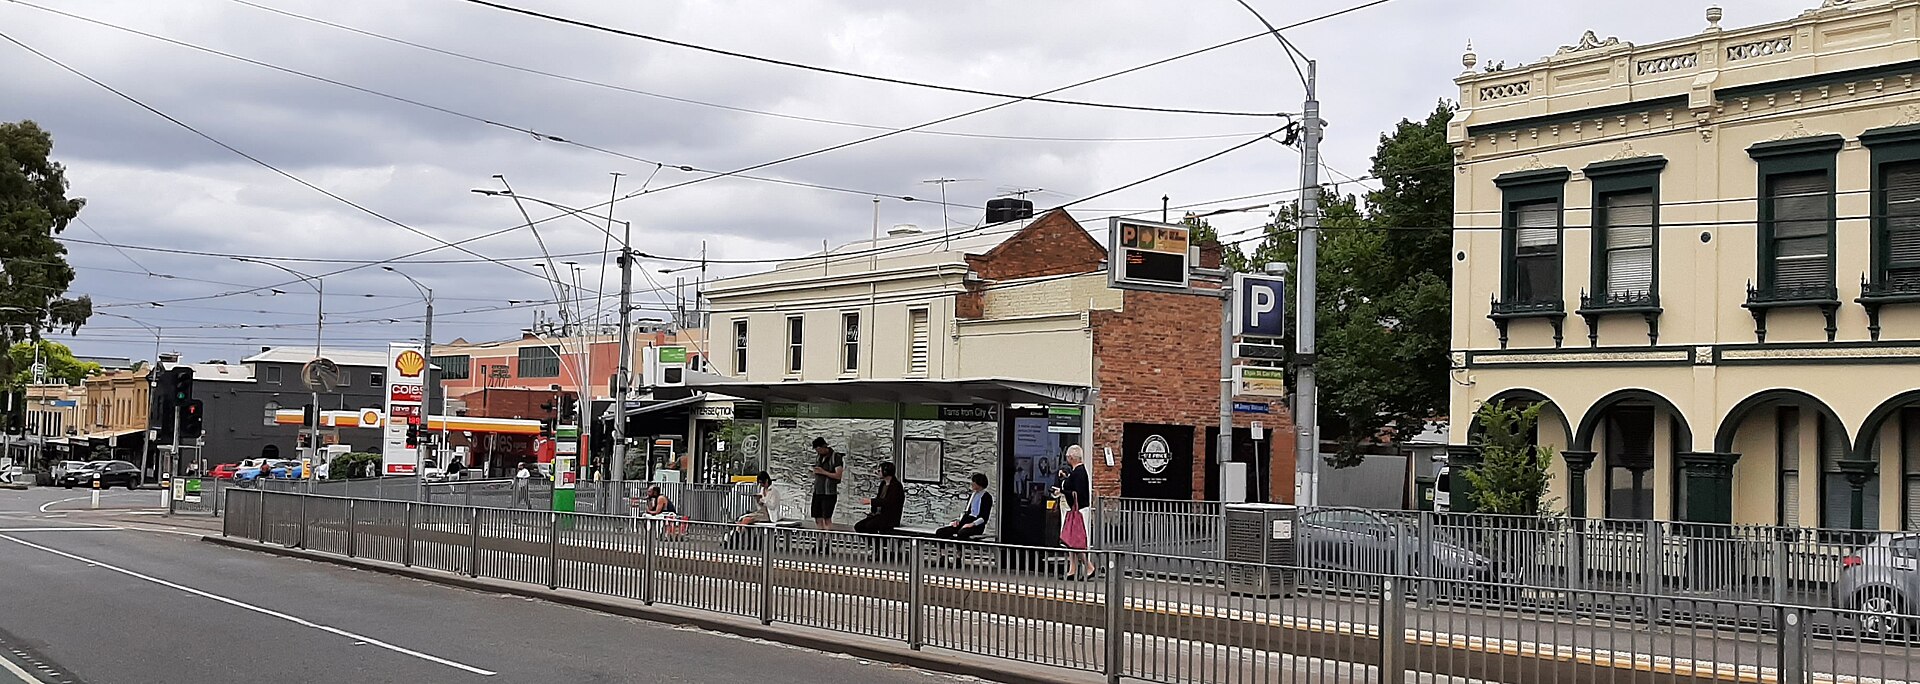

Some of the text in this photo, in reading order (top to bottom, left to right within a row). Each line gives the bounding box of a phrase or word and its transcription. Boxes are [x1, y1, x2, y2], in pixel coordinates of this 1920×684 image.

[1123, 226, 1136, 245] P
[1250, 284, 1276, 328] P
[392, 384, 423, 395] coles
[961, 408, 974, 417] from
[975, 407, 986, 419] City
